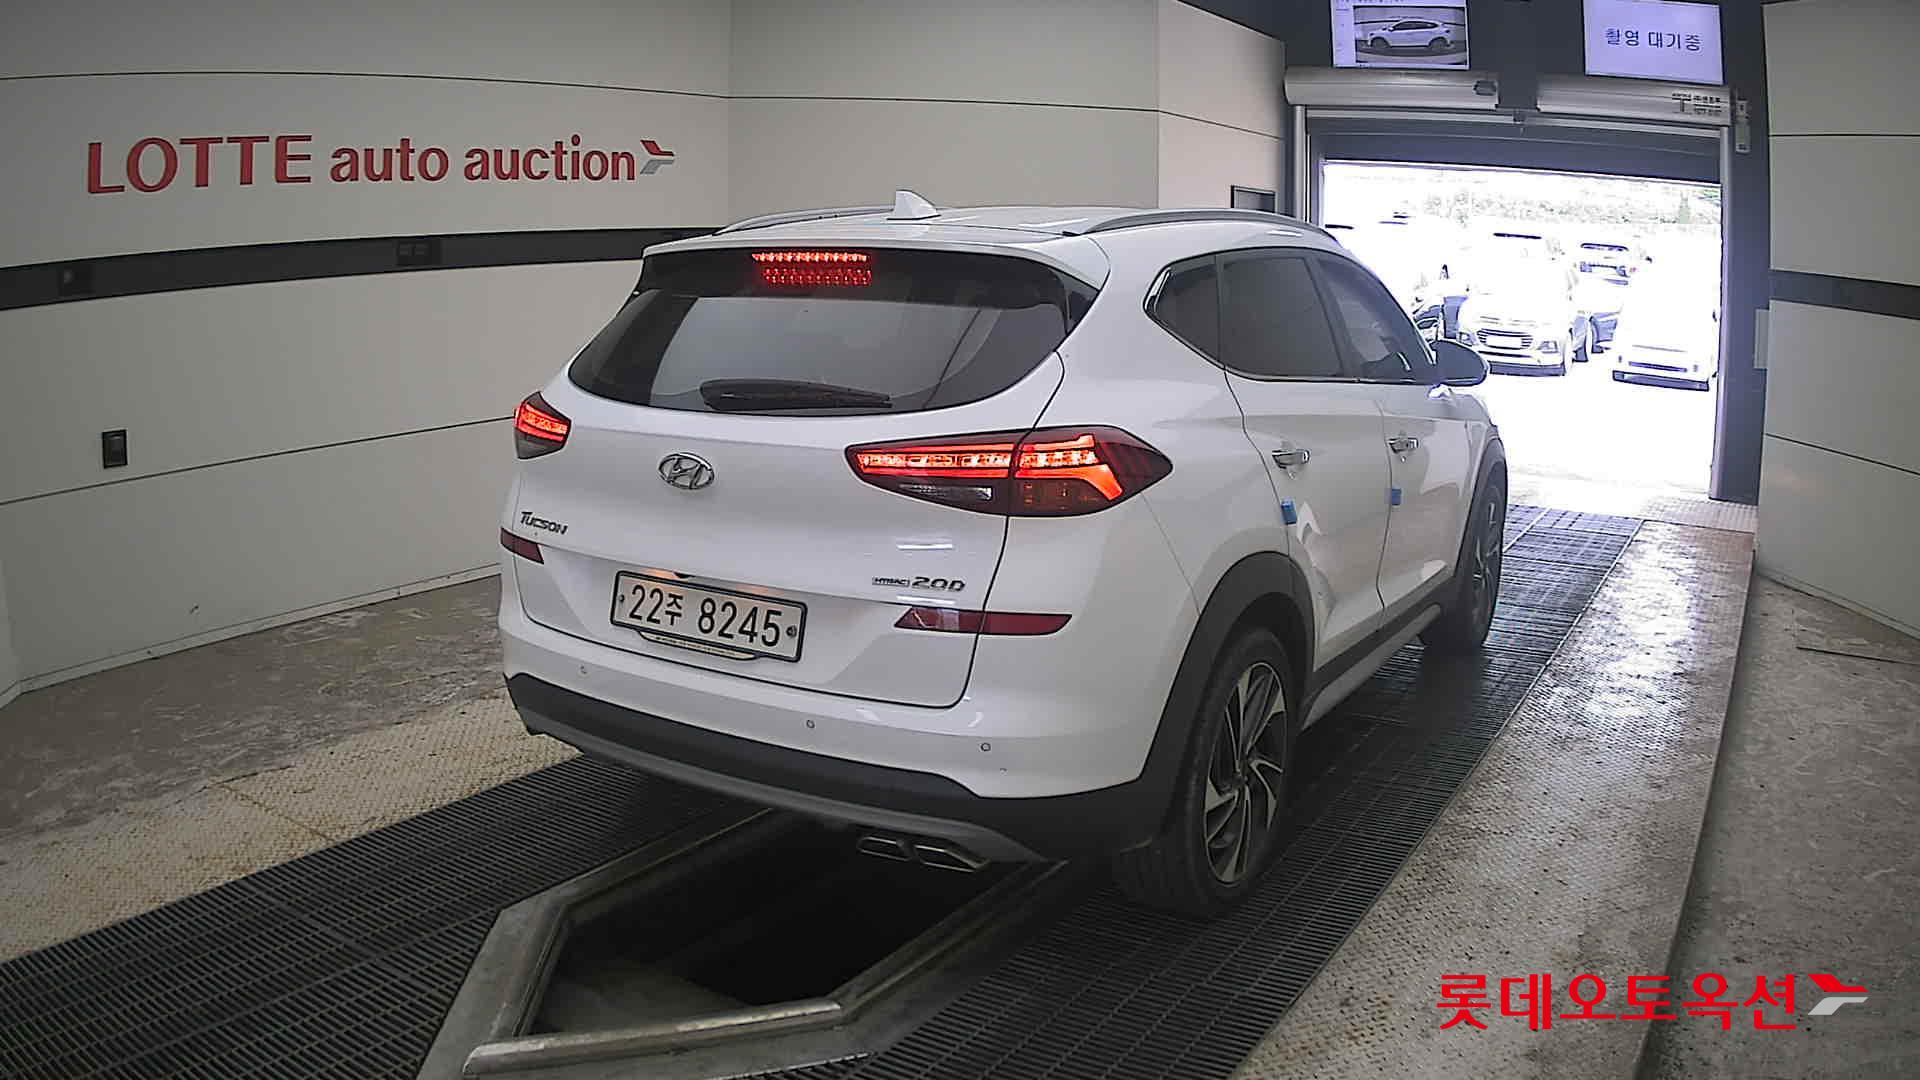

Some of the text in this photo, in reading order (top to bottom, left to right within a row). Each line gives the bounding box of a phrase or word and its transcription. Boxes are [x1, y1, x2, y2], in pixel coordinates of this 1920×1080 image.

[1605, 27, 1702, 52] 촬영 대기중
[87, 133, 636, 195] LOTTE auto auction
[520, 511, 569, 535] TUCSON
[911, 576, 966, 592] 20D
[628, 584, 684, 627] 22주
[697, 597, 783, 648] 8245
